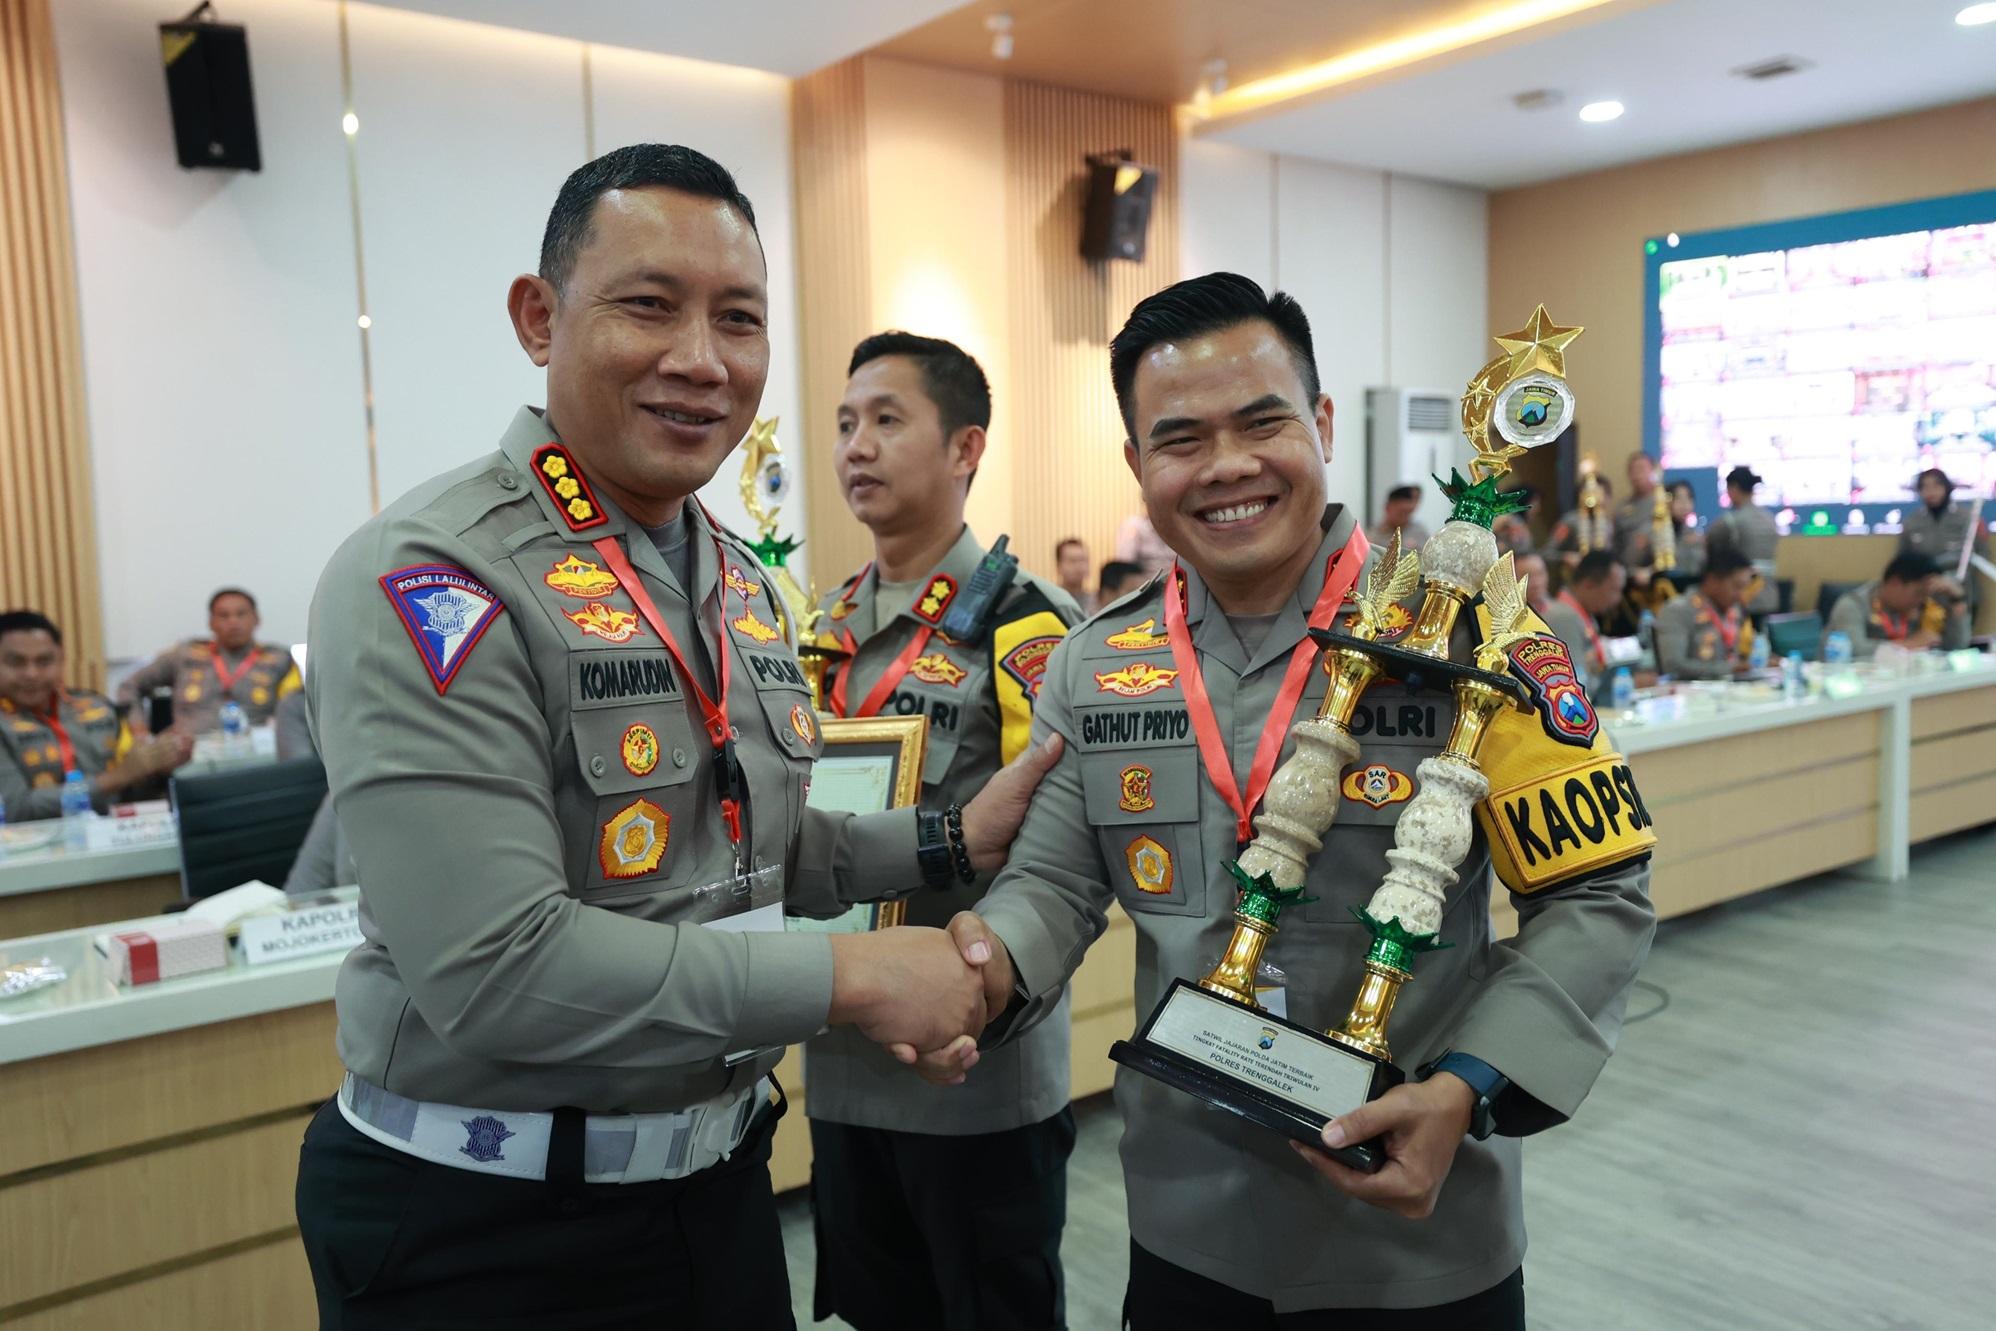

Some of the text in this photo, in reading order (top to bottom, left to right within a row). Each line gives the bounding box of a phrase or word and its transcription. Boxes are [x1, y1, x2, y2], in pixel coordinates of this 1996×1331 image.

[397, 575, 432, 590] POLISI
[580, 658, 677, 700] KOMARUDIN
[749, 655, 807, 688] POLRI
[888, 691, 959, 731] OLRI
[1082, 709, 1190, 745] GATHUT PRIYO
[1317, 705, 1436, 738] OLRI
[1368, 769, 1387, 779] SAR
[1193, 1035, 1215, 1048] TINGKAT
[1215, 1044, 1240, 1058] FATALITY
[1240, 1054, 1254, 1064] RATE
[1255, 1060, 1283, 1076] TERENDAH
[1283, 1072, 1312, 1088] TRIWULAN
[1203, 1030, 1314, 1080] SATWIL JAJARAN POLDA JATIM TERBAIK
[1210, 1052, 1294, 1093] POLRES TRENGGALEK
